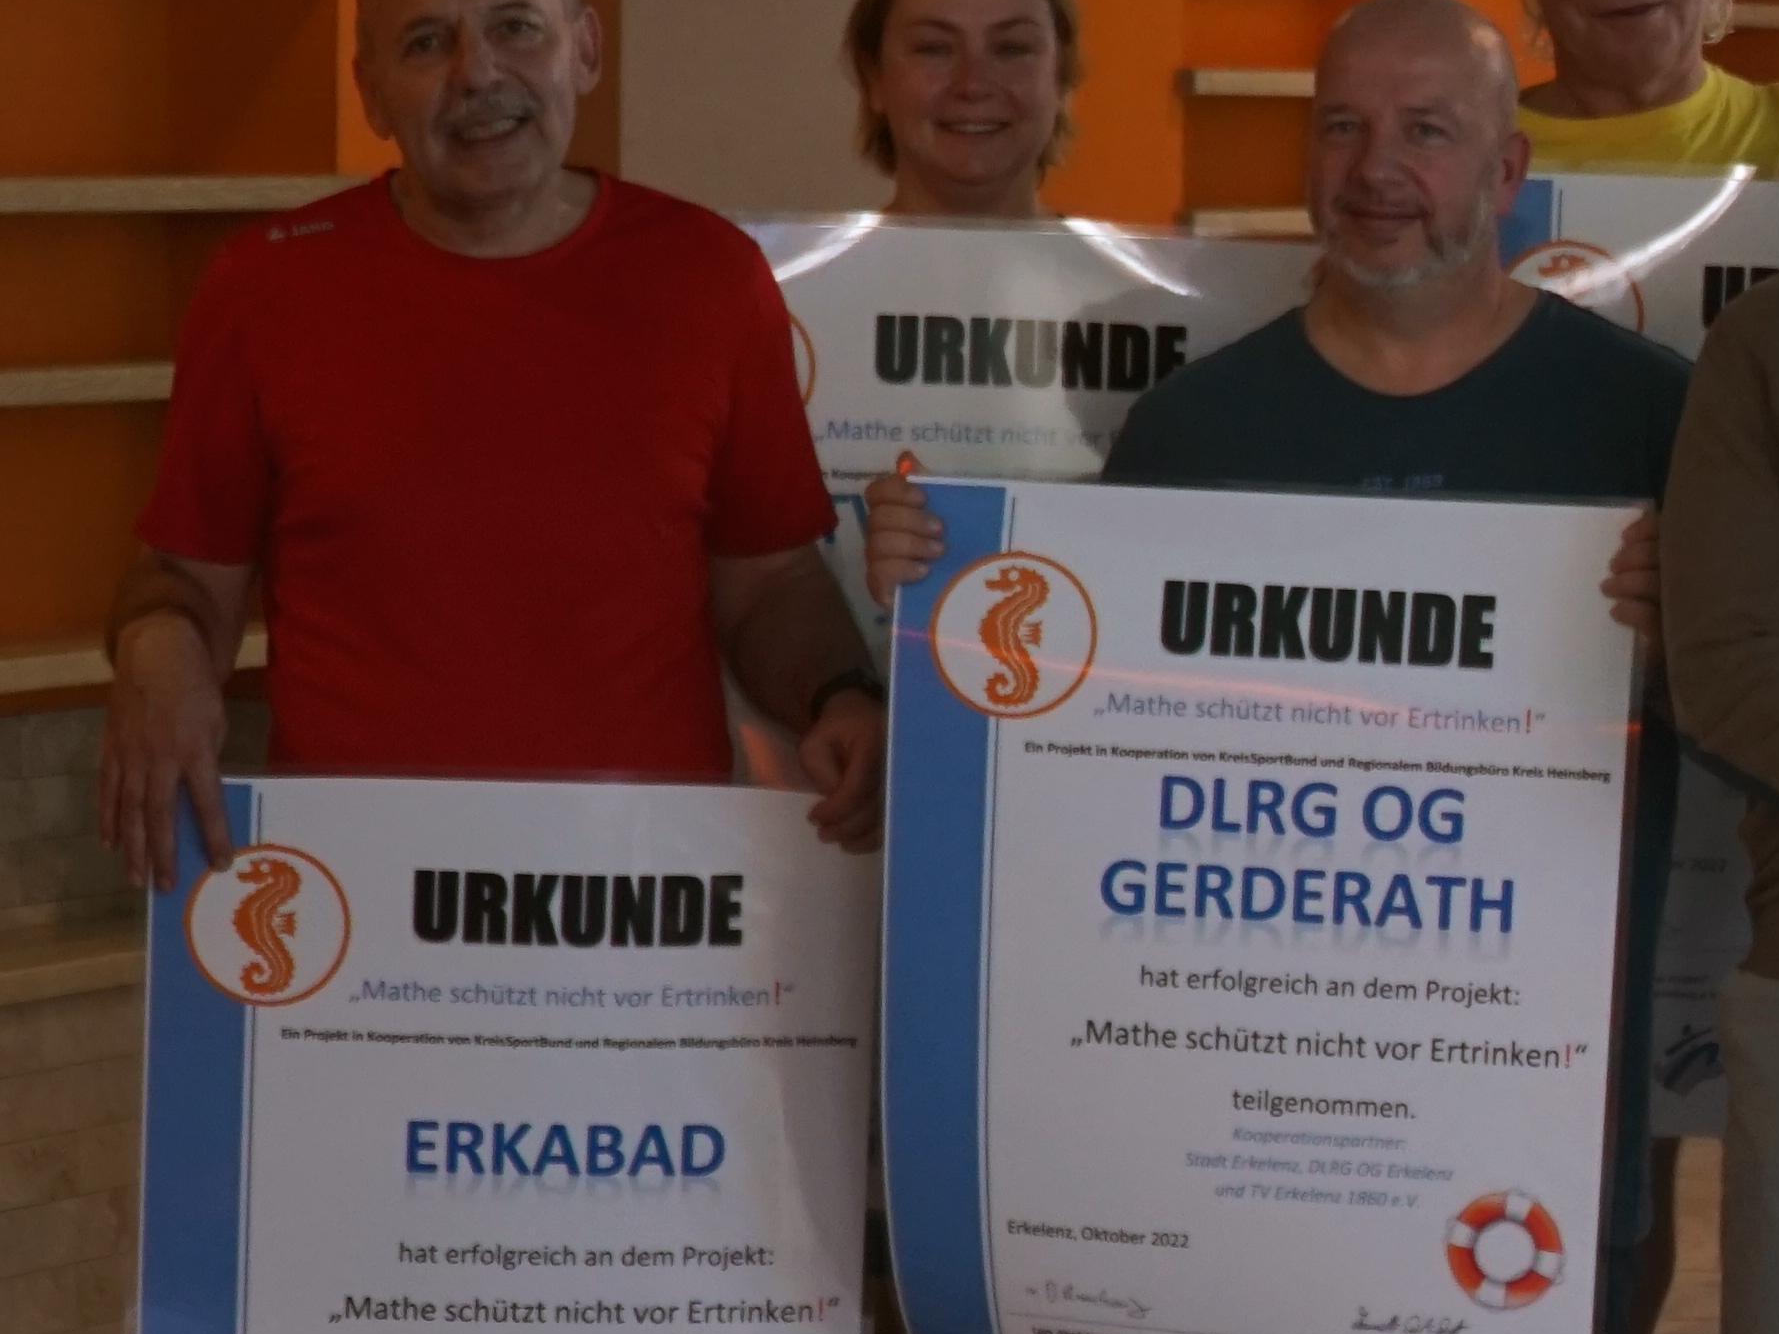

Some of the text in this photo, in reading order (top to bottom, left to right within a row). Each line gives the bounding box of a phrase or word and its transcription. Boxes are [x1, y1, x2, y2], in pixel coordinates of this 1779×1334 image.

[912, 422, 994, 446] schützt
[1161, 579, 1497, 669] URKUNDE
[1196, 696, 1284, 723] schützt
[1291, 702, 1352, 727] nicht
[1358, 710, 1399, 728] vor
[1025, 742, 1043, 754] Ein
[1048, 743, 1092, 758] Projekt
[1111, 746, 1189, 761] Kooperation
[1193, 752, 1215, 762] von
[1321, 757, 1344, 768] und
[1160, 774, 1465, 843] DLRG OG
[412, 870, 744, 948] URKUNDE
[1101, 859, 1514, 933] GERDERATH
[450, 983, 538, 1007] schützt
[546, 985, 606, 1008] nicht
[614, 991, 653, 1008] vor
[1140, 965, 1521, 1009] hat erfolgreich an dem Projekt:
[1186, 1024, 1288, 1055] schützt
[1296, 1031, 1366, 1058] nicht
[1374, 1042, 1422, 1062] vor
[1233, 1089, 1416, 1121] teilgenommen.
[406, 1120, 726, 1177] ERKABAD
[1007, 1221, 1190, 1249] Erkelenz, Oktober 2022
[399, 1242, 774, 1272] hat erfolgreich an dem Projekt:
[444, 1298, 546, 1325] schützt
[554, 1300, 625, 1325] nicht
[633, 1307, 679, 1326] vor
